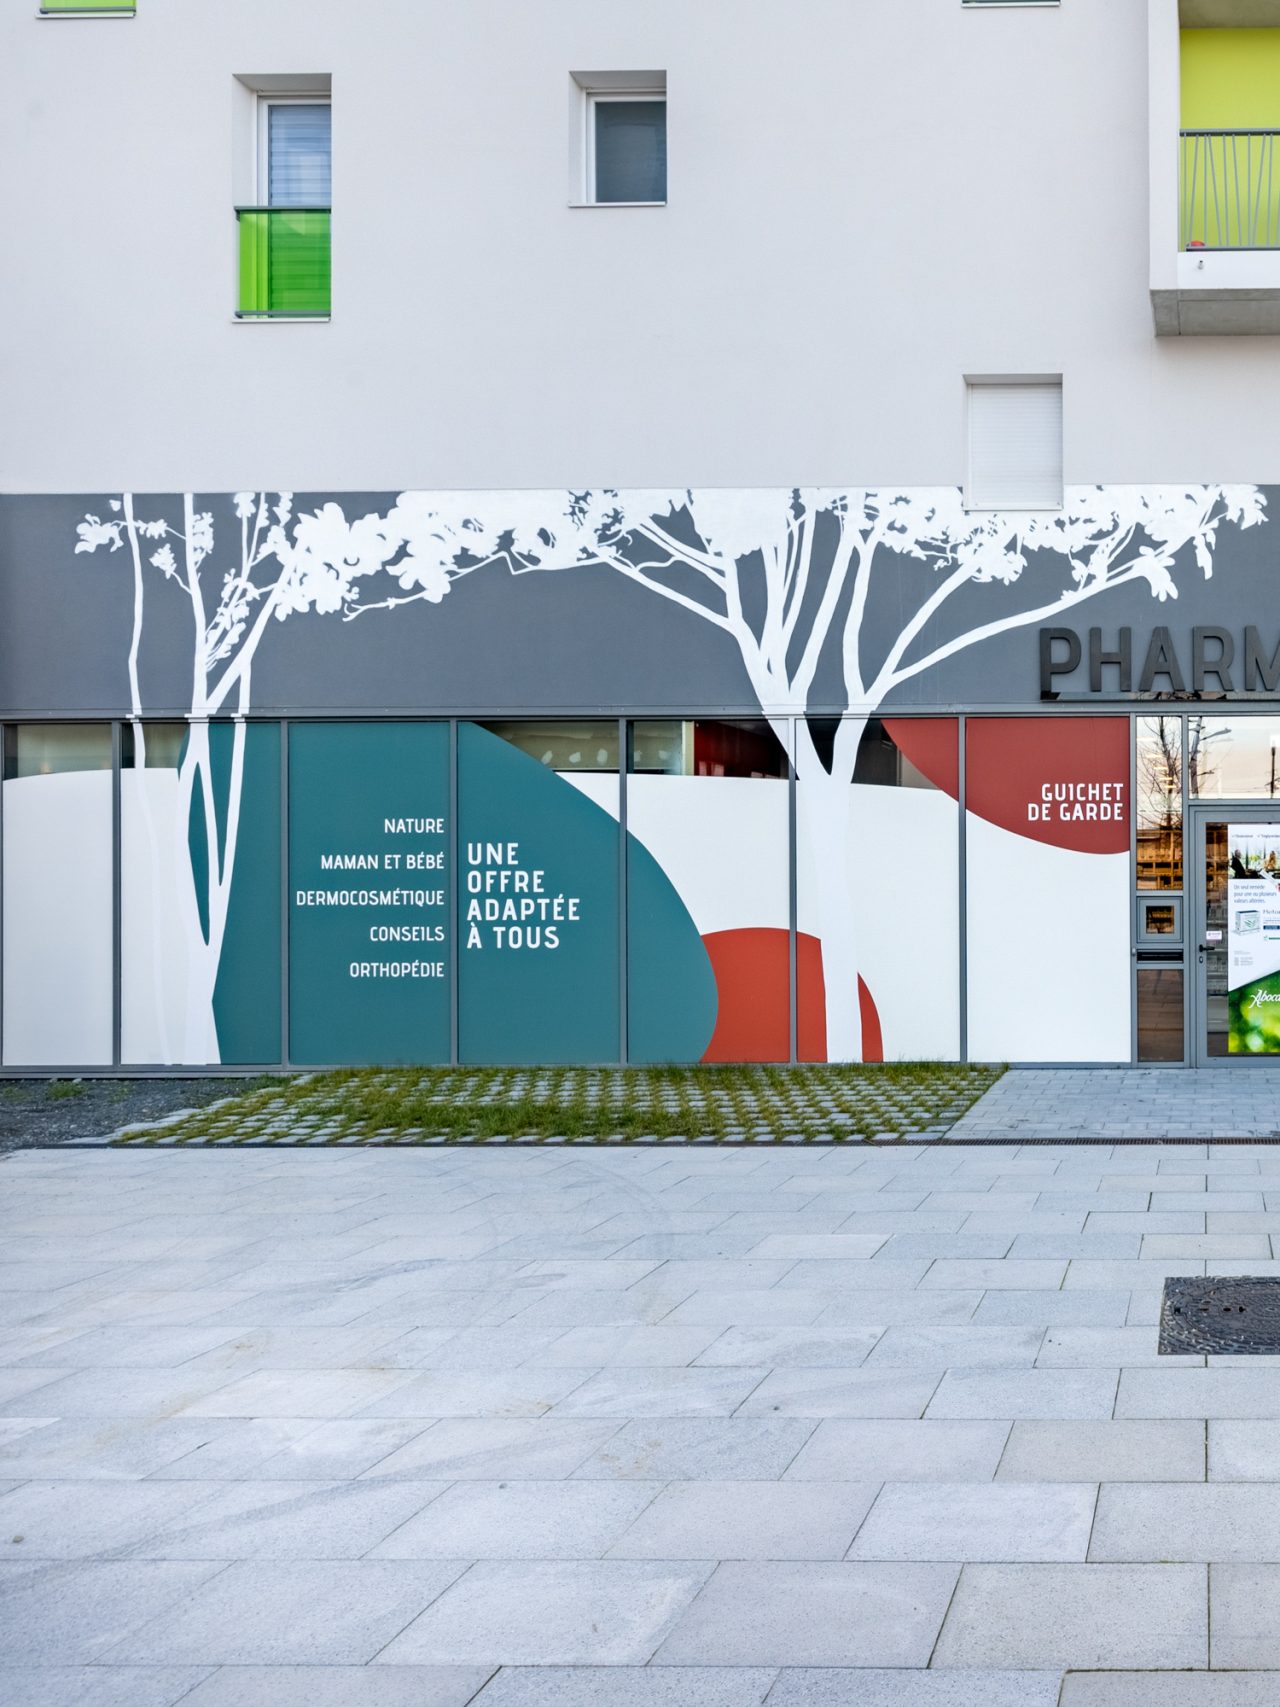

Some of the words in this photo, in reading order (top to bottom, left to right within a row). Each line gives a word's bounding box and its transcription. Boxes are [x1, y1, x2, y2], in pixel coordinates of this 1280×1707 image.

[1041, 783, 1124, 801] GUICHET
[1027, 803, 1052, 821] DE
[1059, 803, 1124, 821] GARDE
[384, 818, 445, 834] NATURE
[320, 854, 379, 870] MAMAN
[384, 854, 402, 870] ET
[406, 851, 445, 870] BÉBÉ
[467, 842, 519, 866] UNE
[467, 871, 545, 894] OFFRE
[296, 887, 445, 907] DERMOCOSMÉTIQUE
[467, 895, 580, 921] ADAPTÉE
[369, 926, 445, 942] CONSEILS
[467, 923, 482, 949] À
[493, 926, 560, 949] TOUS
[349, 959, 445, 978] ORTHOPÉDIE
